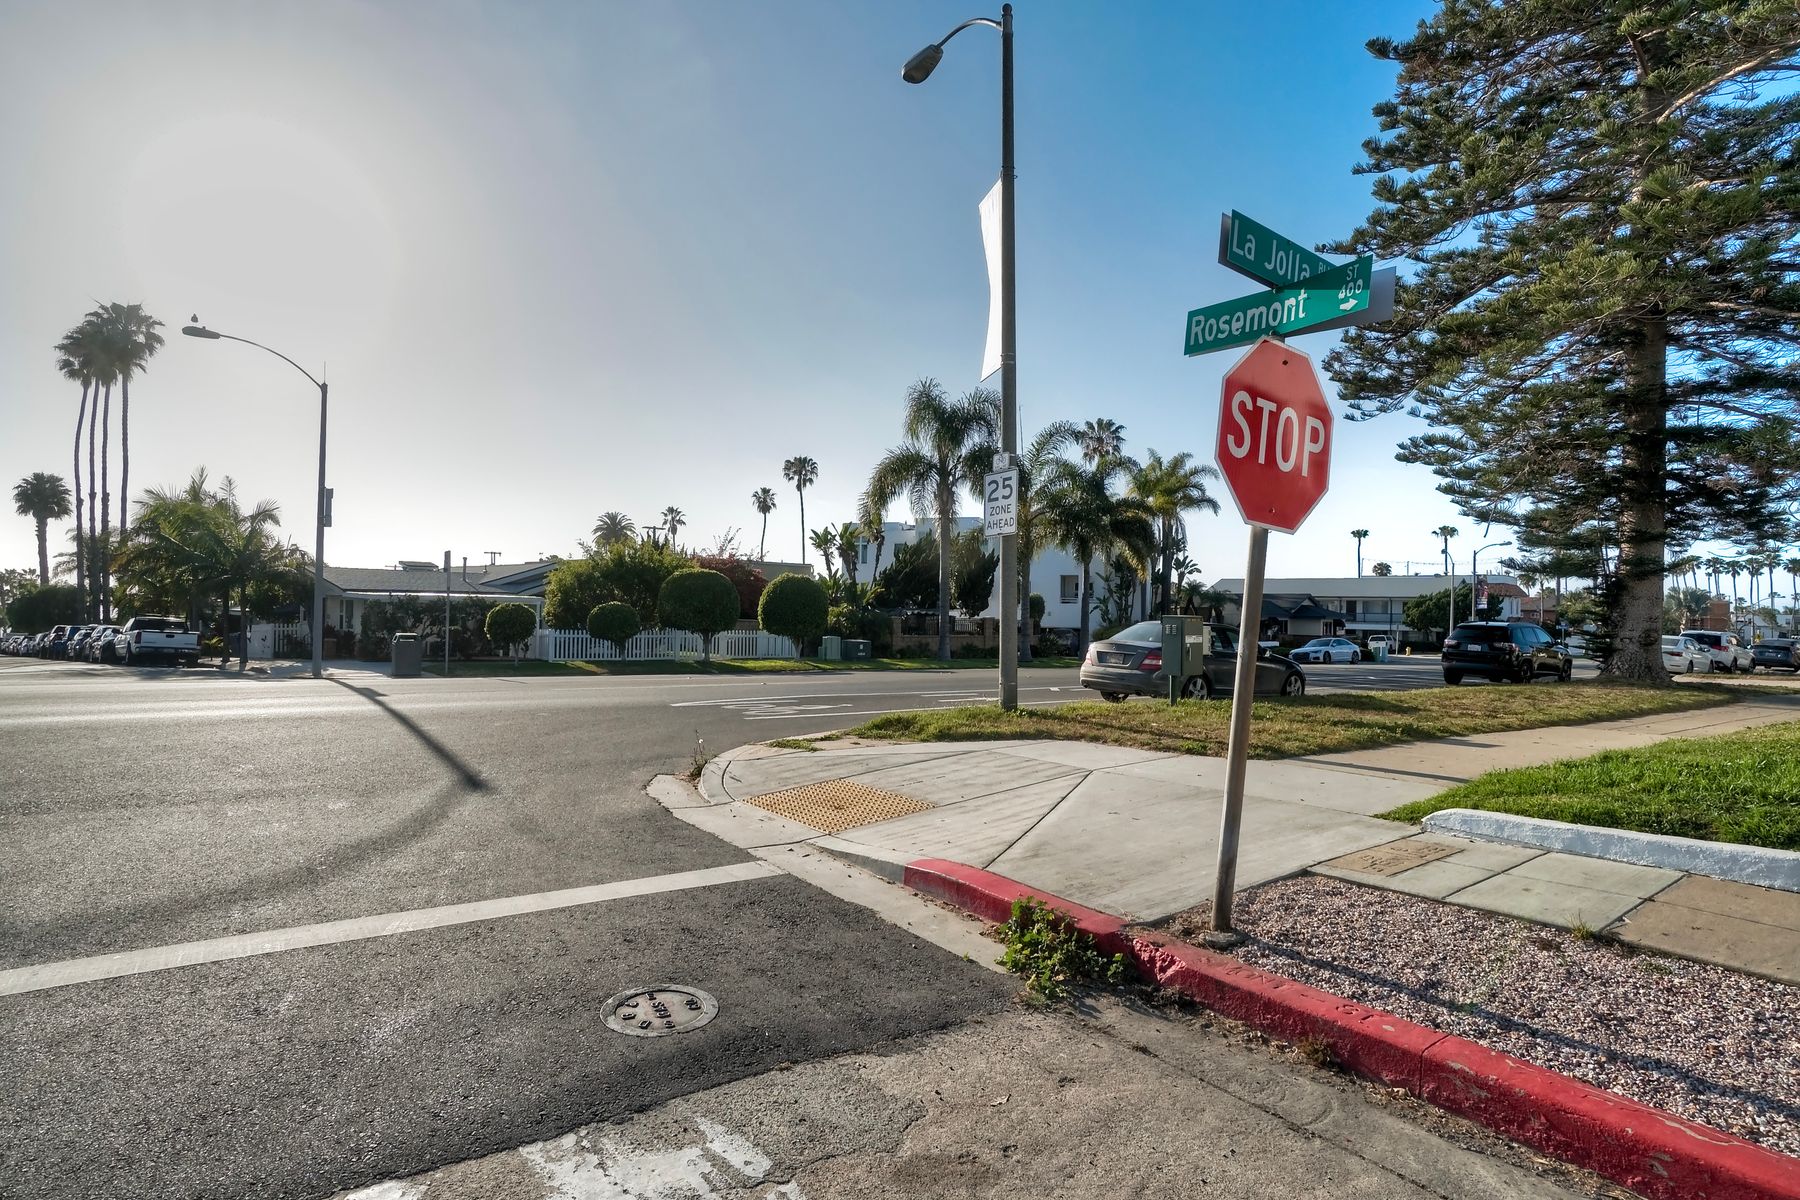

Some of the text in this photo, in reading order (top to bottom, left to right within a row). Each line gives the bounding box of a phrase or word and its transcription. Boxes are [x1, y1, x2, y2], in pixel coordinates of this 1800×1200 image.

[1232, 219, 1256, 262] La
[1264, 239, 1310, 283] Jolla
[1346, 264, 1359, 280] ST
[1338, 279, 1363, 299] 400
[1190, 288, 1308, 346] Rosemont
[1227, 390, 1325, 477] STOP
[987, 476, 1013, 503] 25
[989, 503, 1012, 516] ZONE
[987, 517, 1014, 530] AHEAD
